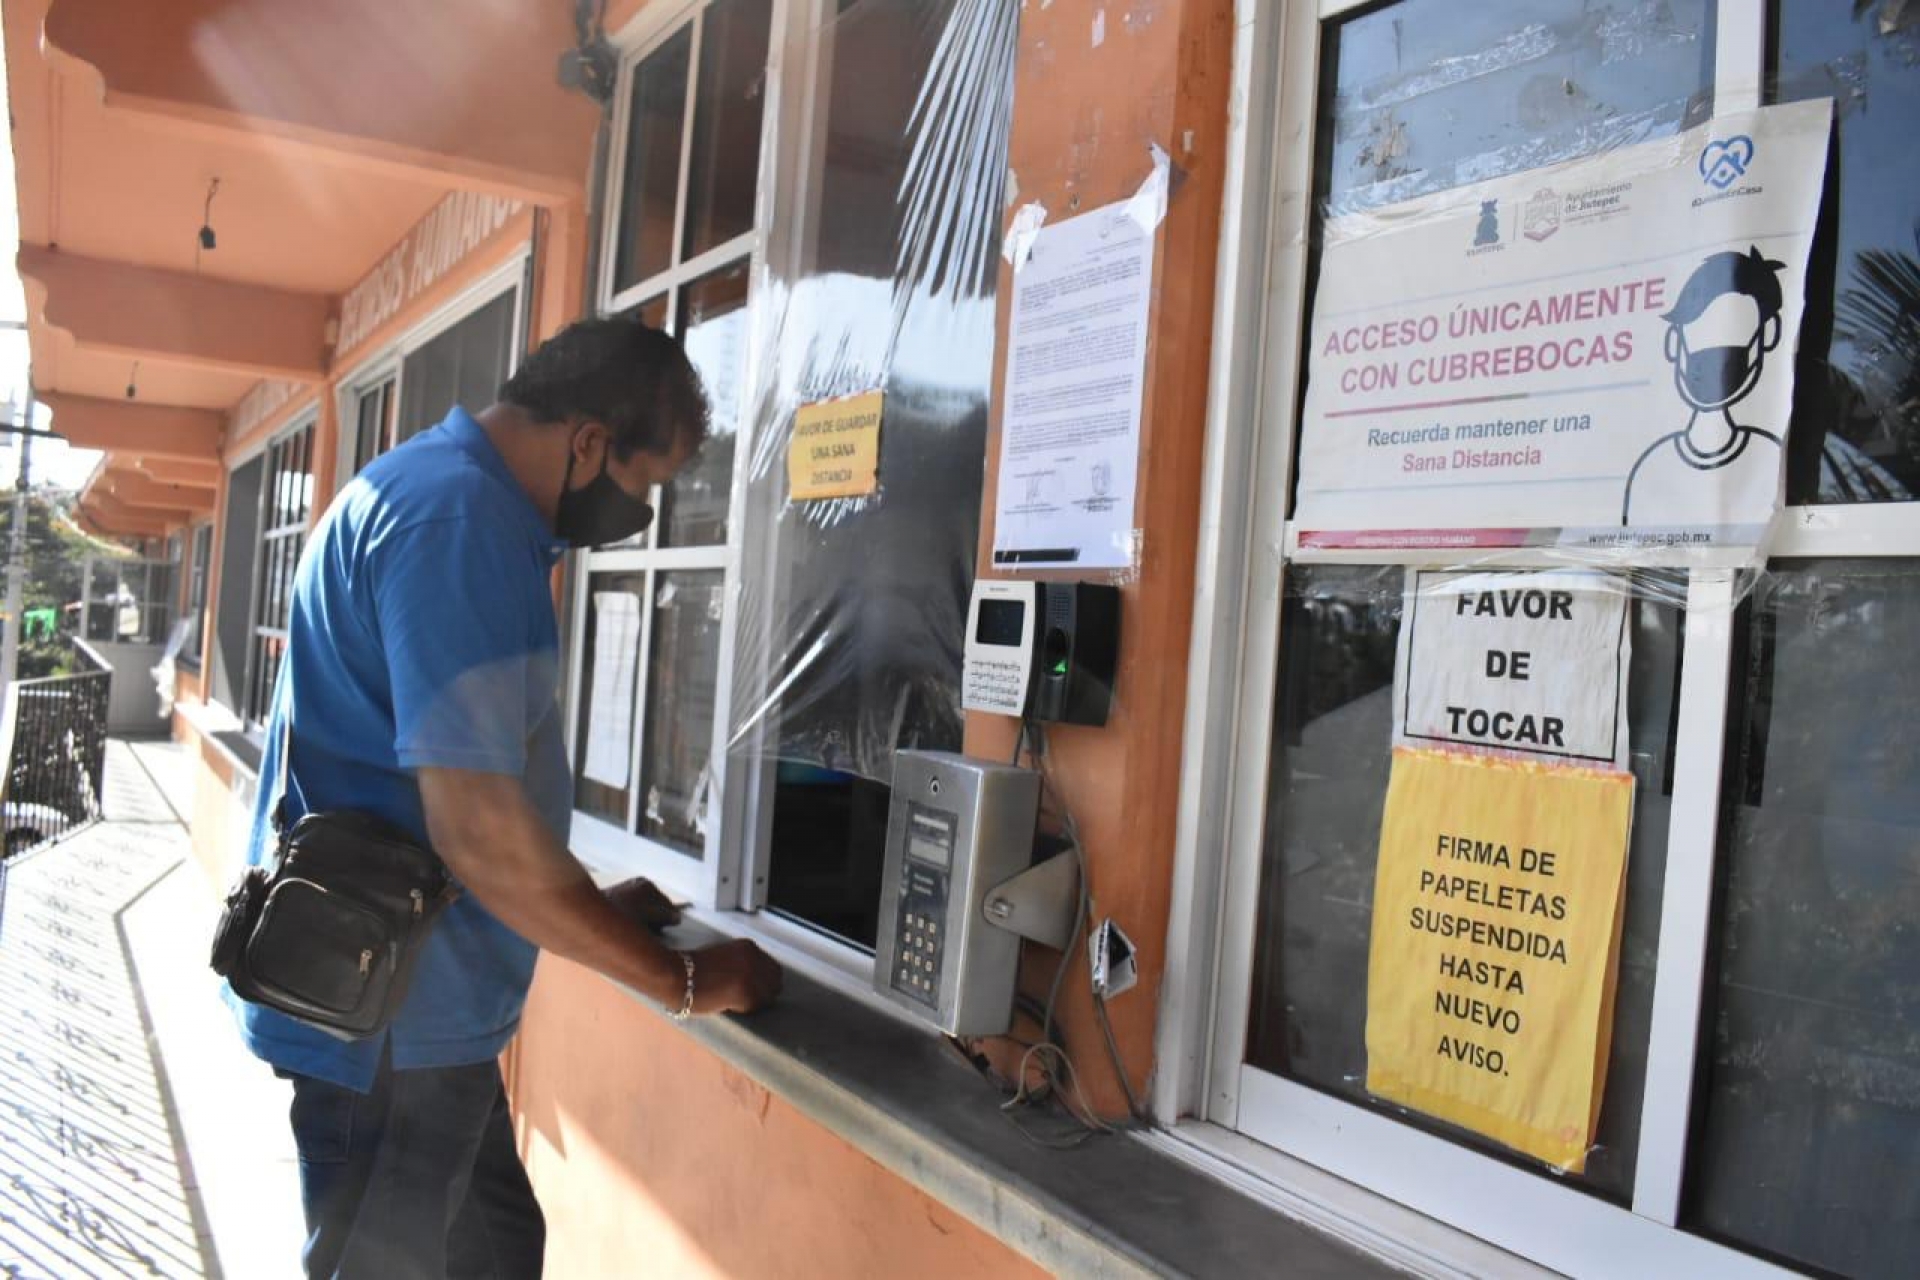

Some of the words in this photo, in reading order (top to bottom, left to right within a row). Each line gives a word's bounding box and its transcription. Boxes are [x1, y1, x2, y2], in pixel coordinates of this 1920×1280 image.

[1323, 316, 1438, 357] ACCESO
[1449, 277, 1666, 338] ÚNICAMENTE
[1341, 362, 1399, 393] CON
[1408, 331, 1633, 386] CUBREBOCAS
[1368, 423, 1450, 447] Recuerda
[1455, 417, 1548, 440] mantener
[1553, 414, 1591, 433] una
[1403, 452, 1447, 473] Sana
[1452, 446, 1542, 469] Distancia
[1456, 590, 1573, 620] FAVOR
[1485, 649, 1531, 680] DE
[1446, 706, 1565, 747] TOCAR
[1437, 834, 1510, 869] FIRMA
[1520, 847, 1556, 877] DE
[1420, 869, 1567, 921] PAPELETAS
[1410, 907, 1567, 965] SUSPENDIDA
[1440, 952, 1524, 995] HASTA
[1435, 989, 1521, 1035] NUEVO
[1437, 1034, 1509, 1077] AVISO.
